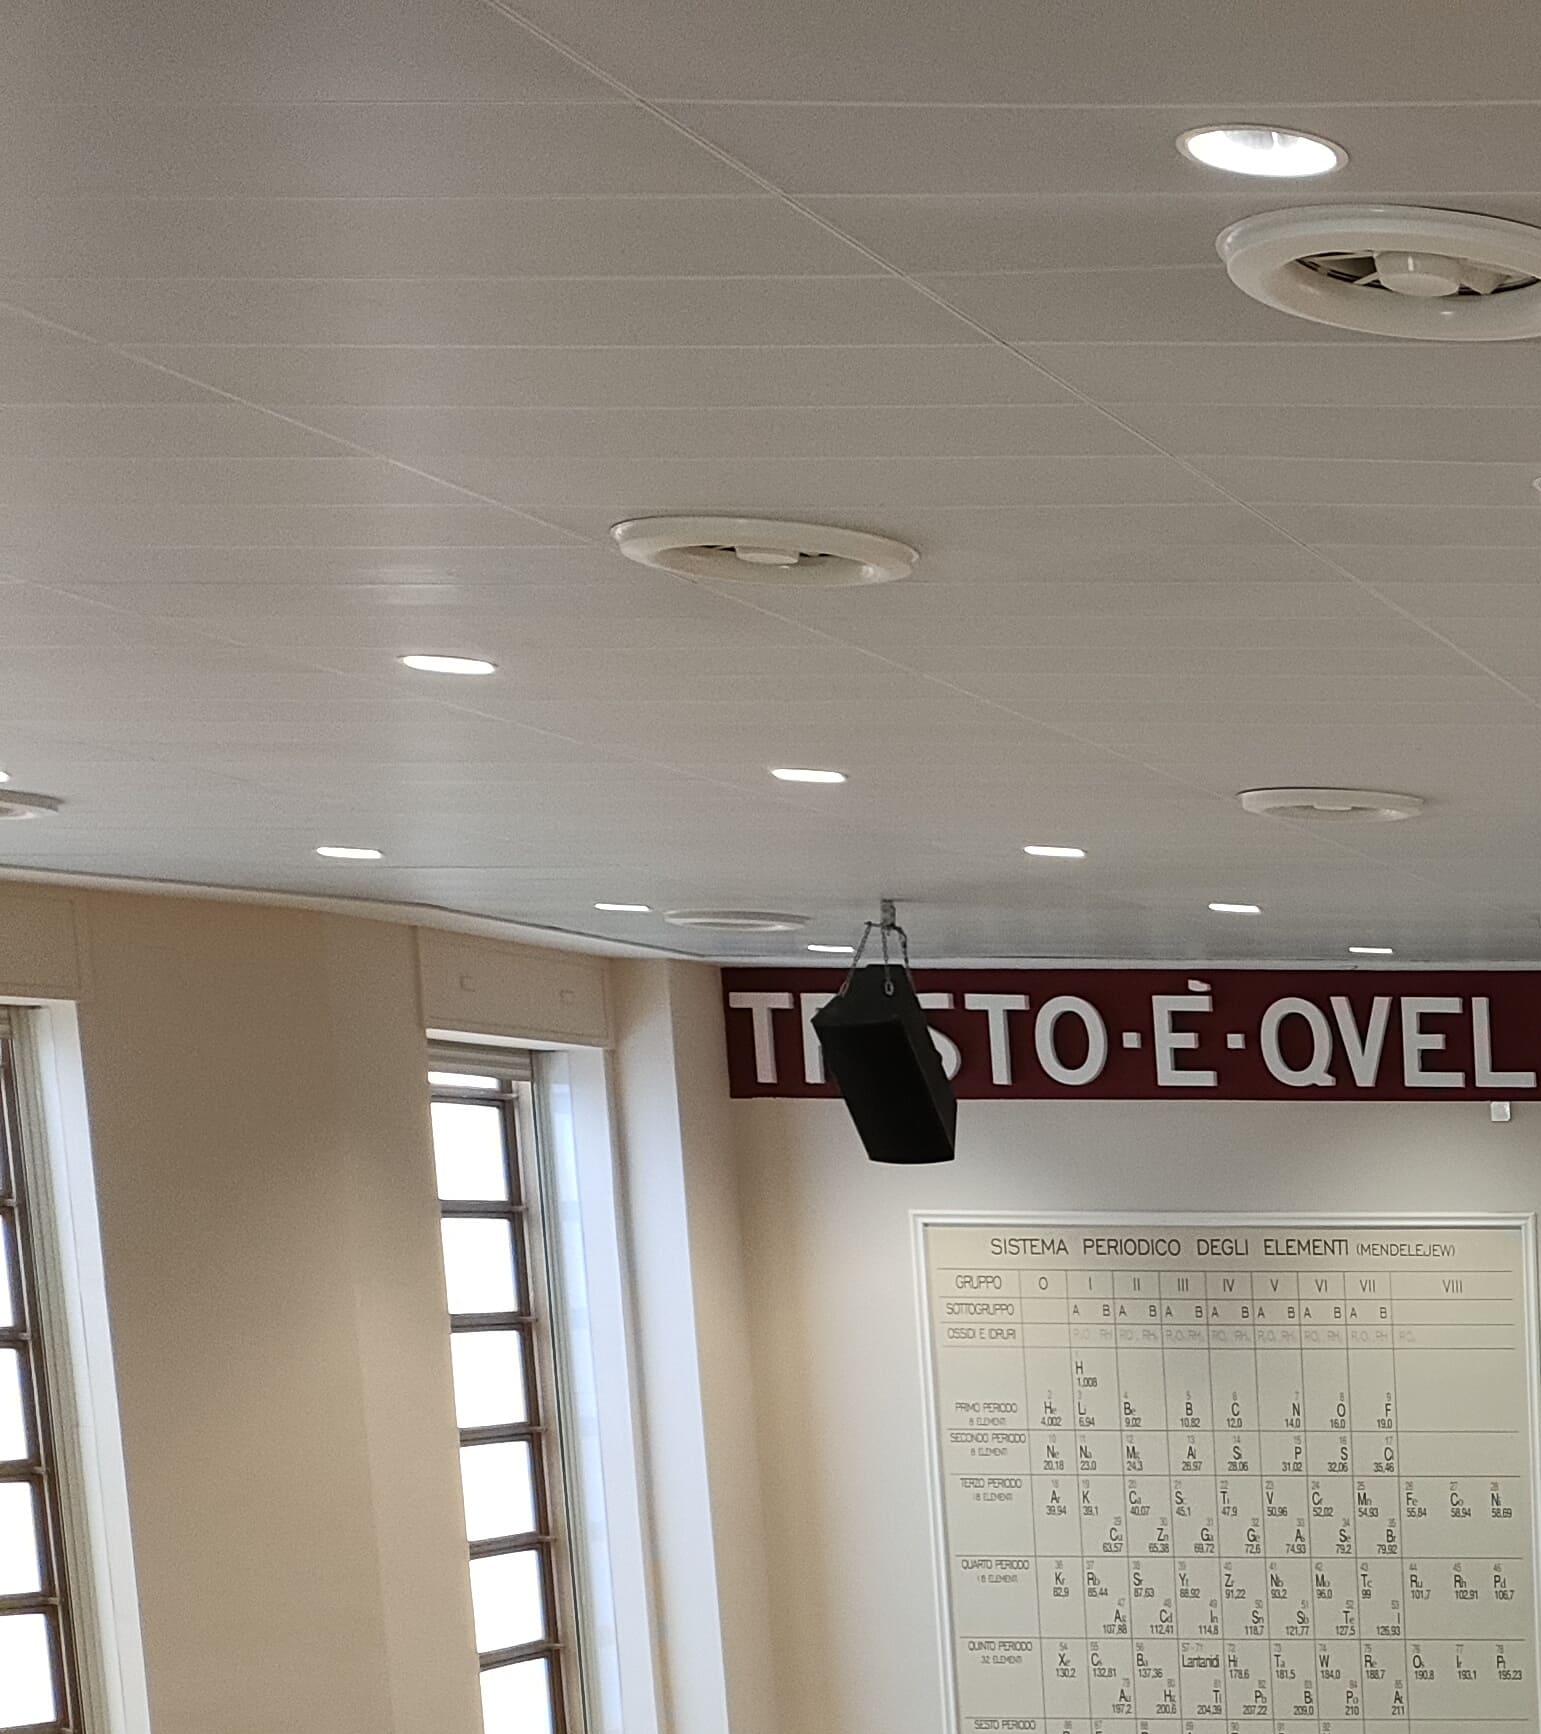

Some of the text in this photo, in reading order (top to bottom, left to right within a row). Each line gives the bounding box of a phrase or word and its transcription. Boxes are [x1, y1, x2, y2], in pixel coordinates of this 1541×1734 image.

[729, 991, 1108, 1088] TSTO
[1151, 979, 1218, 1087] È
[1260, 995, 1537, 1088] QVEL
[990, 1238, 1455, 1258] SISTEMA PERIODICO DEGLI ELEMENTI (MENDELEJEW)
[955, 1275, 1002, 1290] GRUPPO
[1177, 1278, 1189, 1292] III
[1223, 1278, 1235, 1292] IV
[1269, 1278, 1279, 1292] V
[1314, 1279, 1328, 1293] VI
[1359, 1279, 1376, 1293] VII
[1442, 1279, 1463, 1293] VIII
[1072, 1304, 1387, 1319] A B A B A B A B A B A B A B
[1075, 1361, 1083, 1374] H
[1185, 1402, 1193, 1417] B
[1231, 1402, 1240, 1417] C
[1292, 1402, 1301, 1417] N
[1385, 1402, 1391, 1417] F
[1294, 1447, 1348, 1460] P S
[1082, 1491, 1090, 1505] K
[1266, 1491, 1274, 1505] V
[1494, 1574, 1506, 1588] Pd
[1319, 1654, 1330, 1668] W
